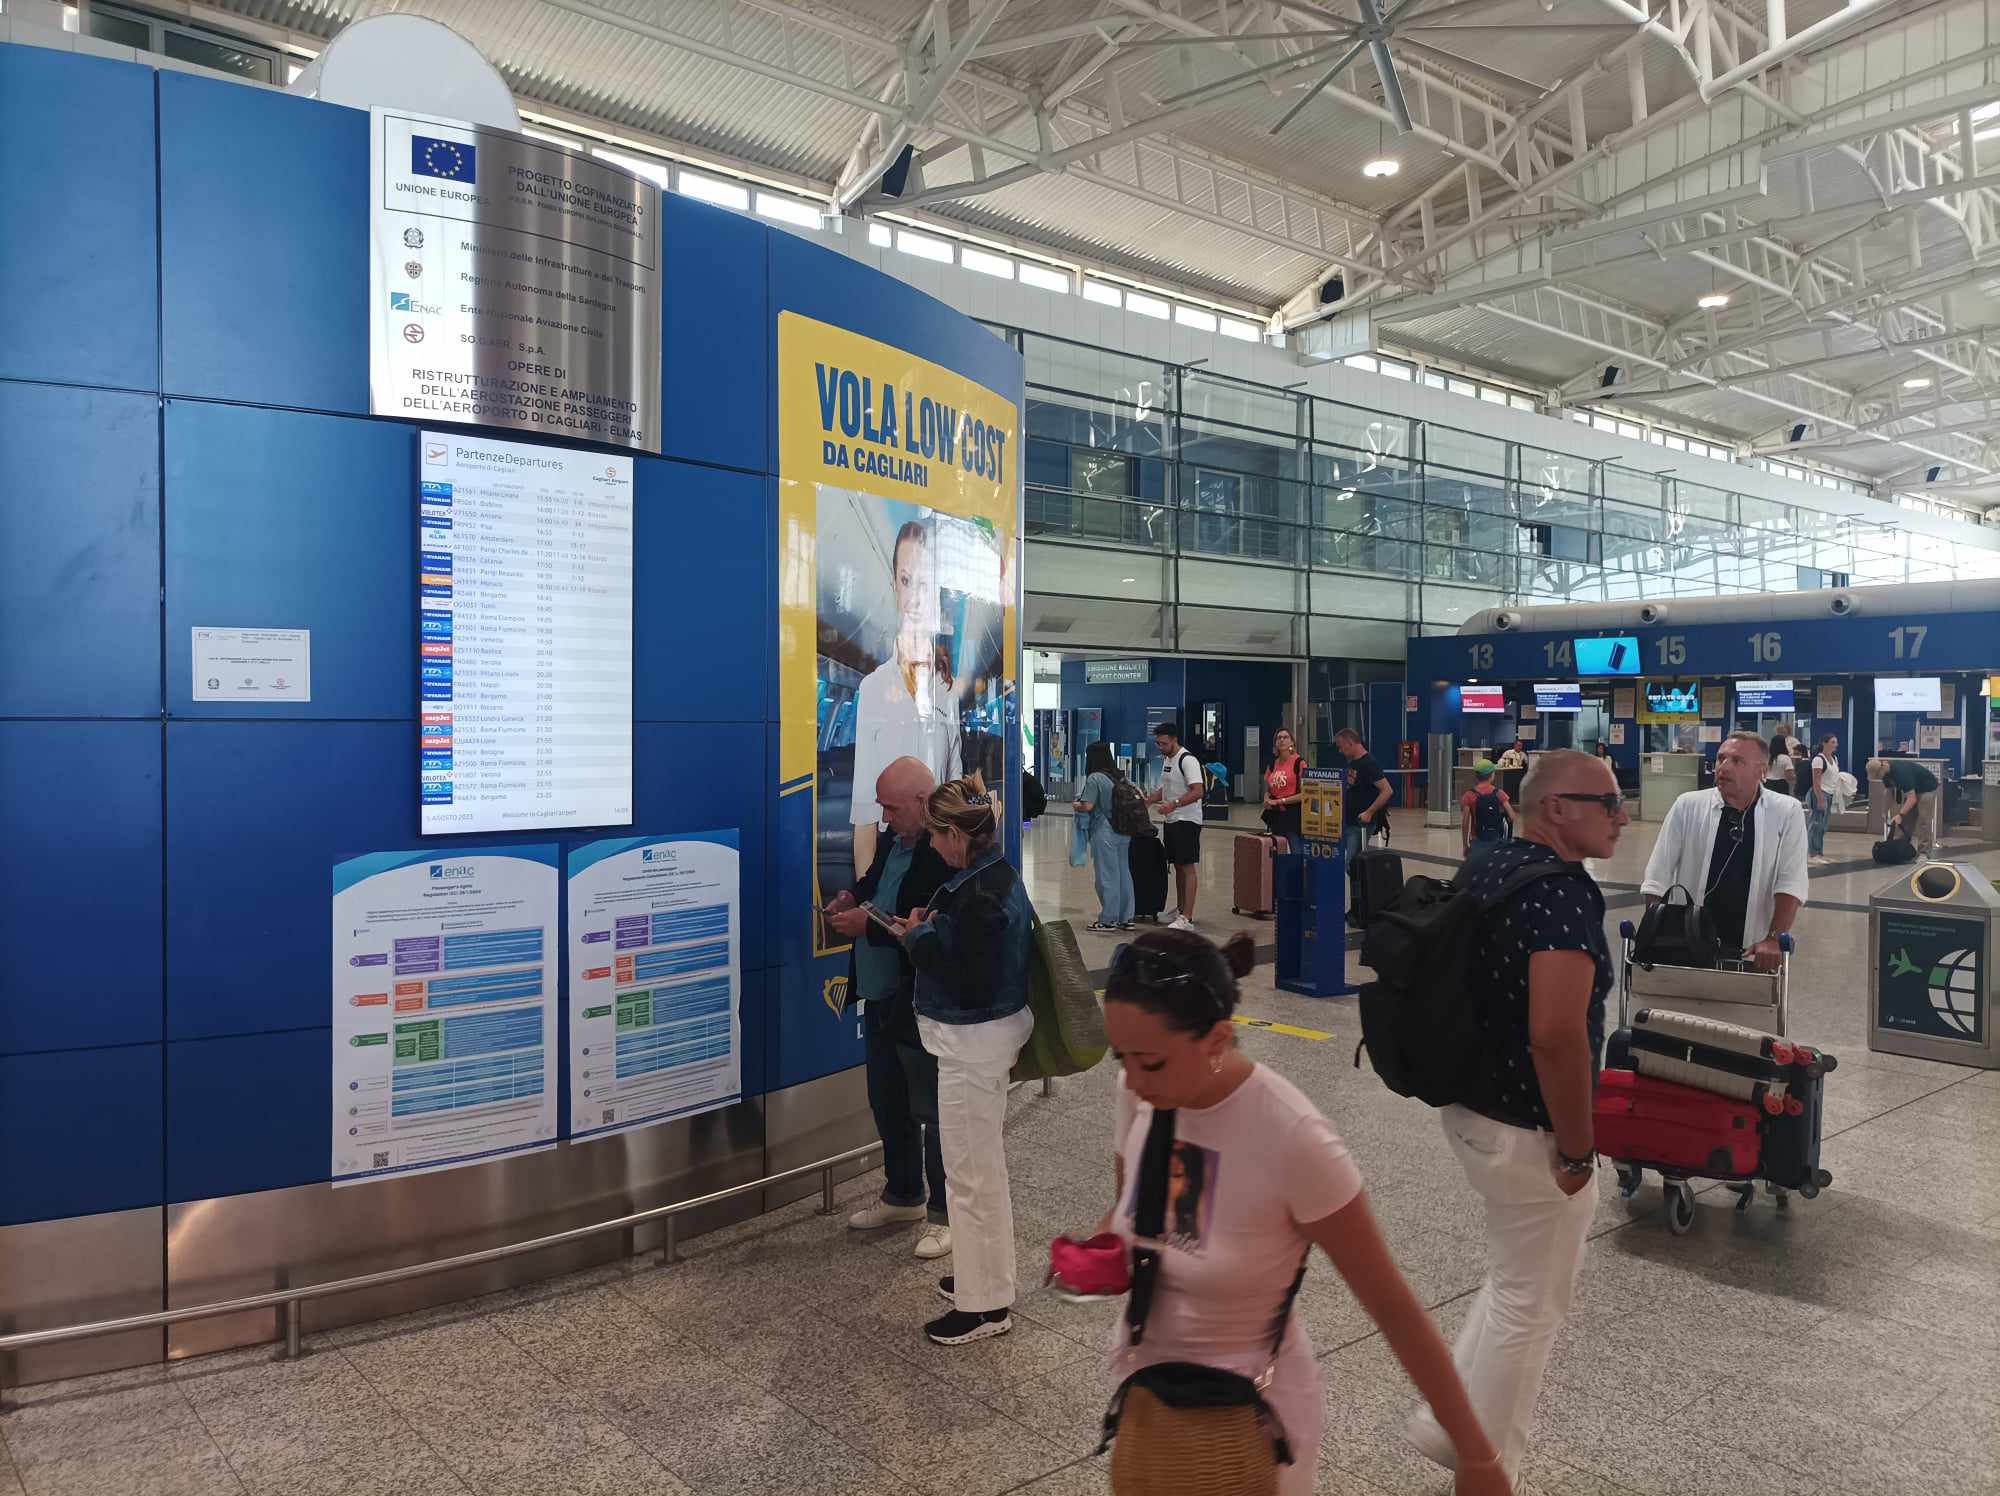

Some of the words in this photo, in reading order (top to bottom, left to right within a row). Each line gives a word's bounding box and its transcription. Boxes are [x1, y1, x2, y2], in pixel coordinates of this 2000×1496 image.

[395, 182, 437, 197] UNIONE
[508, 166, 572, 190] PROGETTO
[574, 183, 644, 215] COFINANZIATO
[516, 181, 590, 209] DALL'UNIONE
[593, 203, 638, 225] EUROPEA
[535, 255, 592, 278] Infrastrutture
[505, 279, 553, 298] Autonoma
[555, 290, 576, 303] della
[536, 317, 578, 333] Aviazione
[412, 368, 547, 396] RISTRUTTURAZIONE
[550, 385, 558, 397] E
[560, 387, 637, 412] AMPLIAMENTO
[508, 360, 551, 376] OPERE
[554, 367, 566, 379] DI
[403, 397, 528, 421] DELL'AEROPORTO
[531, 411, 543, 424] DI
[546, 413, 601, 432] CAGLIARI
[609, 423, 643, 441] ELMAS
[421, 384, 560, 412] DELL'AEROSTAZIONE
[563, 403, 631, 425] PASSEGGERI
[815, 362, 898, 448] VOLA
[905, 391, 956, 465] LOW
[961, 413, 1005, 485] COST
[823, 440, 849, 469] DA
[854, 447, 928, 488] CAGLIARI
[1469, 643, 1494, 671] 13
[1543, 640, 1572, 668] 14
[1655, 635, 1686, 665] 15
[1748, 632, 1782, 663] 16
[1888, 625, 1928, 659] 17
[1308, 770, 1340, 779] RYANAIR
